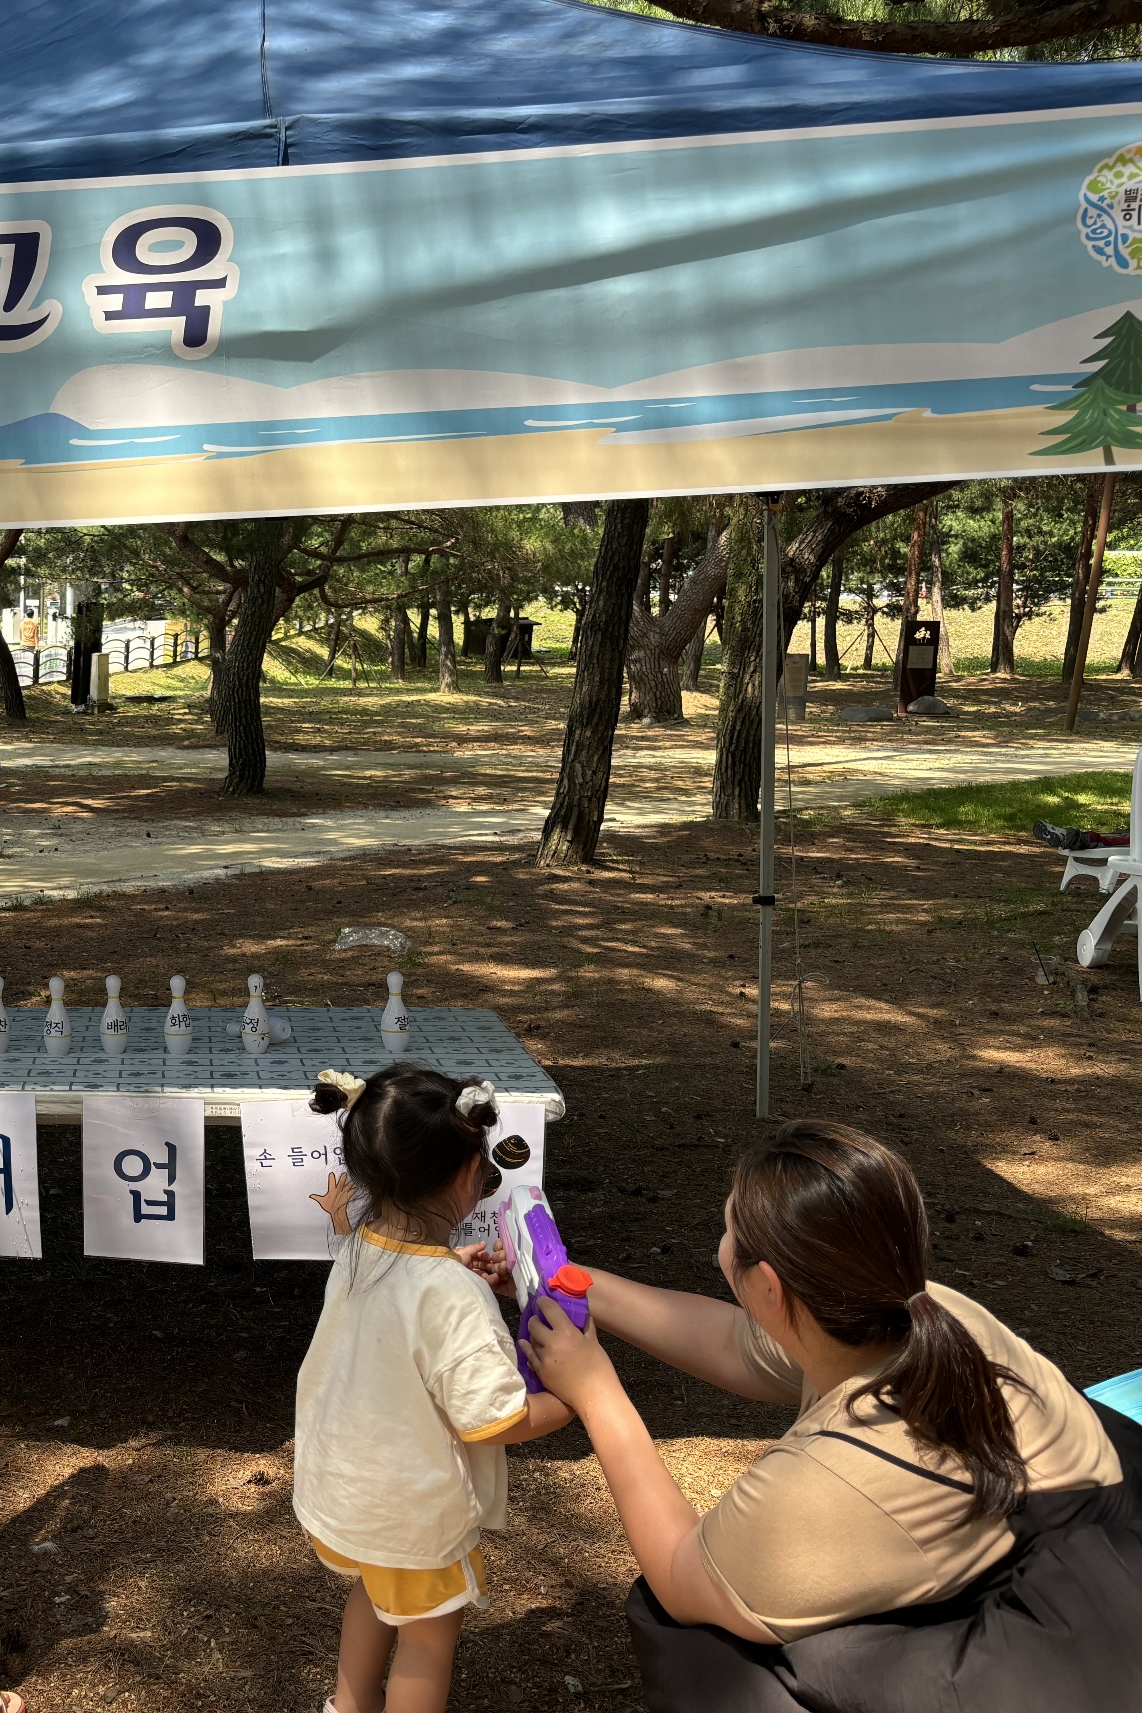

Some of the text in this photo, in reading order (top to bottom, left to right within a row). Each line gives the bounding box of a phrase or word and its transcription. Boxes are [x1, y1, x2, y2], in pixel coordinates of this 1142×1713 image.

[44, 1020, 64, 1036] 정직
[169, 1013, 191, 1029] 화합
[395, 1015, 411, 1031] 절
[255, 1148, 276, 1168] 손
[113, 1140, 177, 1224] 업
